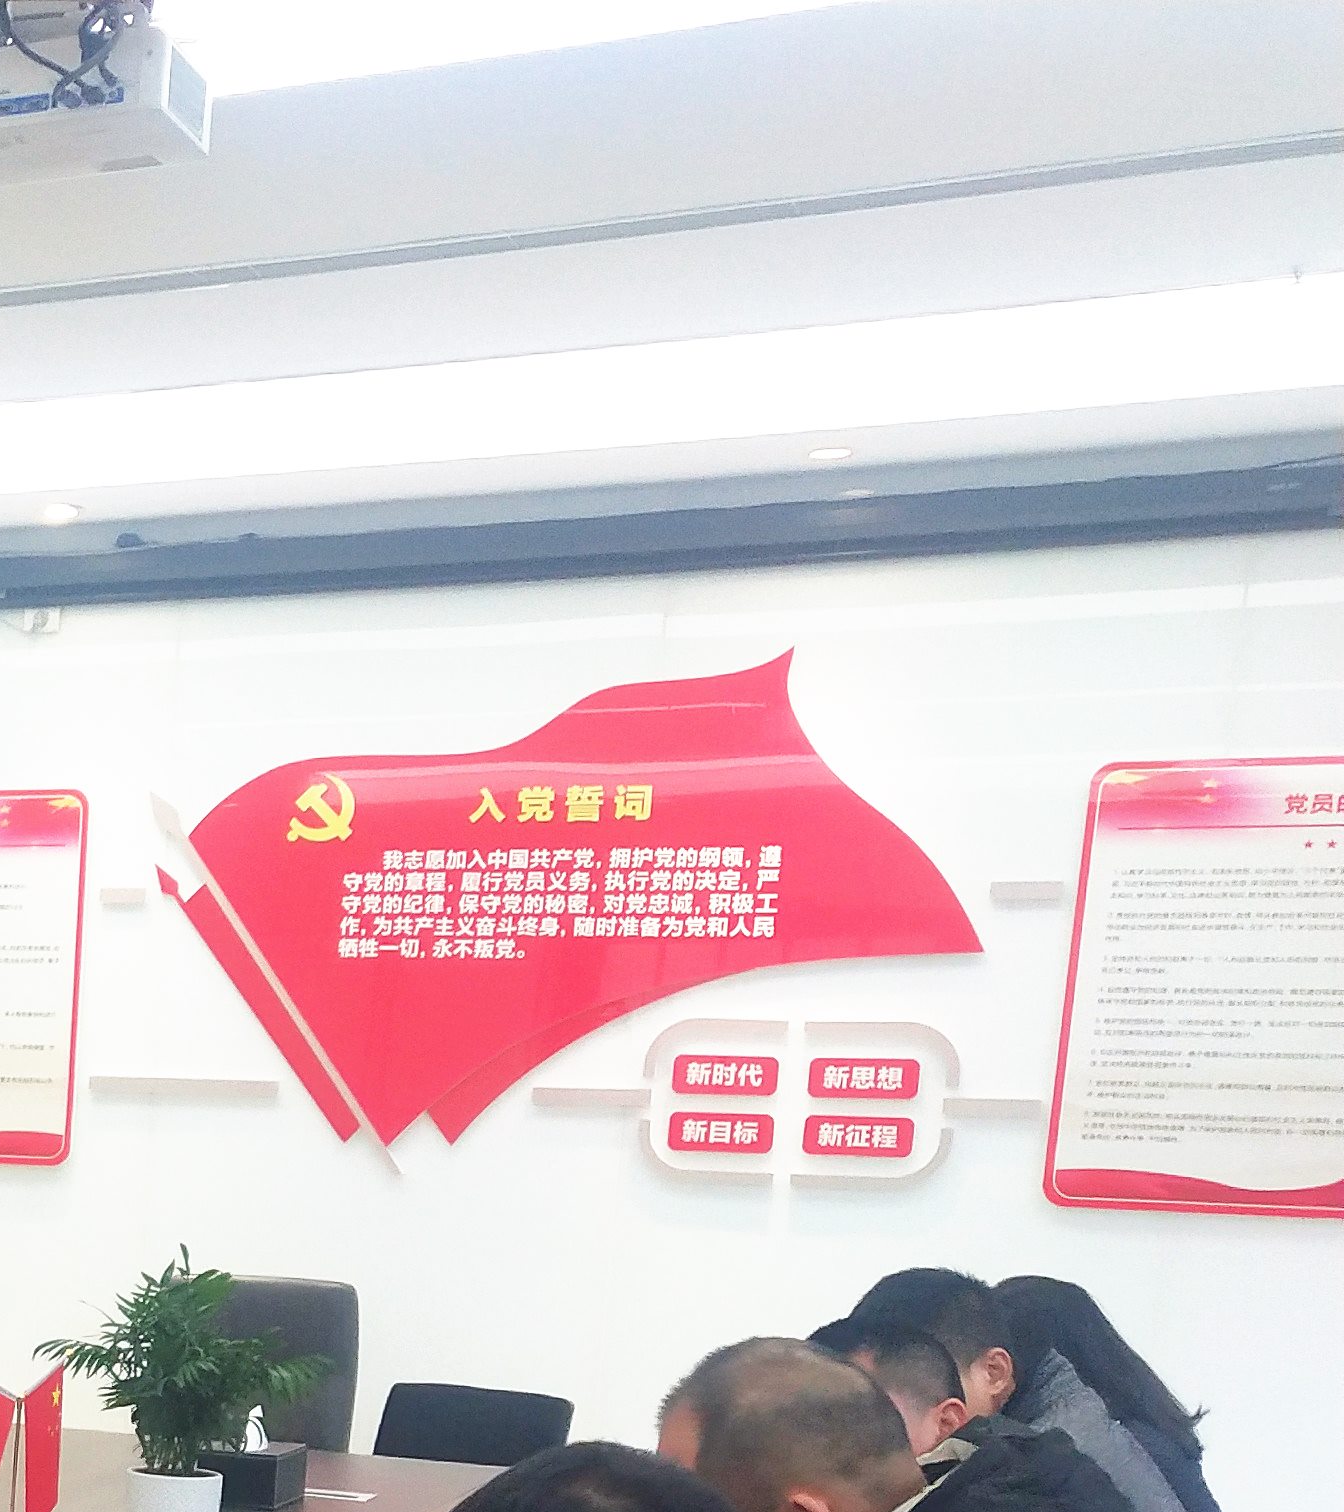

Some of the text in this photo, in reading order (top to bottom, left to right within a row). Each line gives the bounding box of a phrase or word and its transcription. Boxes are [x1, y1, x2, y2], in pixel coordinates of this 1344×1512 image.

[468, 784, 654, 824] 入党誓词
[337, 938, 526, 959] 牺牲一切，永不叛党。
[685, 1062, 764, 1087] 新时代
[823, 1065, 904, 1091] 新思想
[681, 1119, 759, 1145] 新目标
[817, 1122, 899, 1149] 新征程
